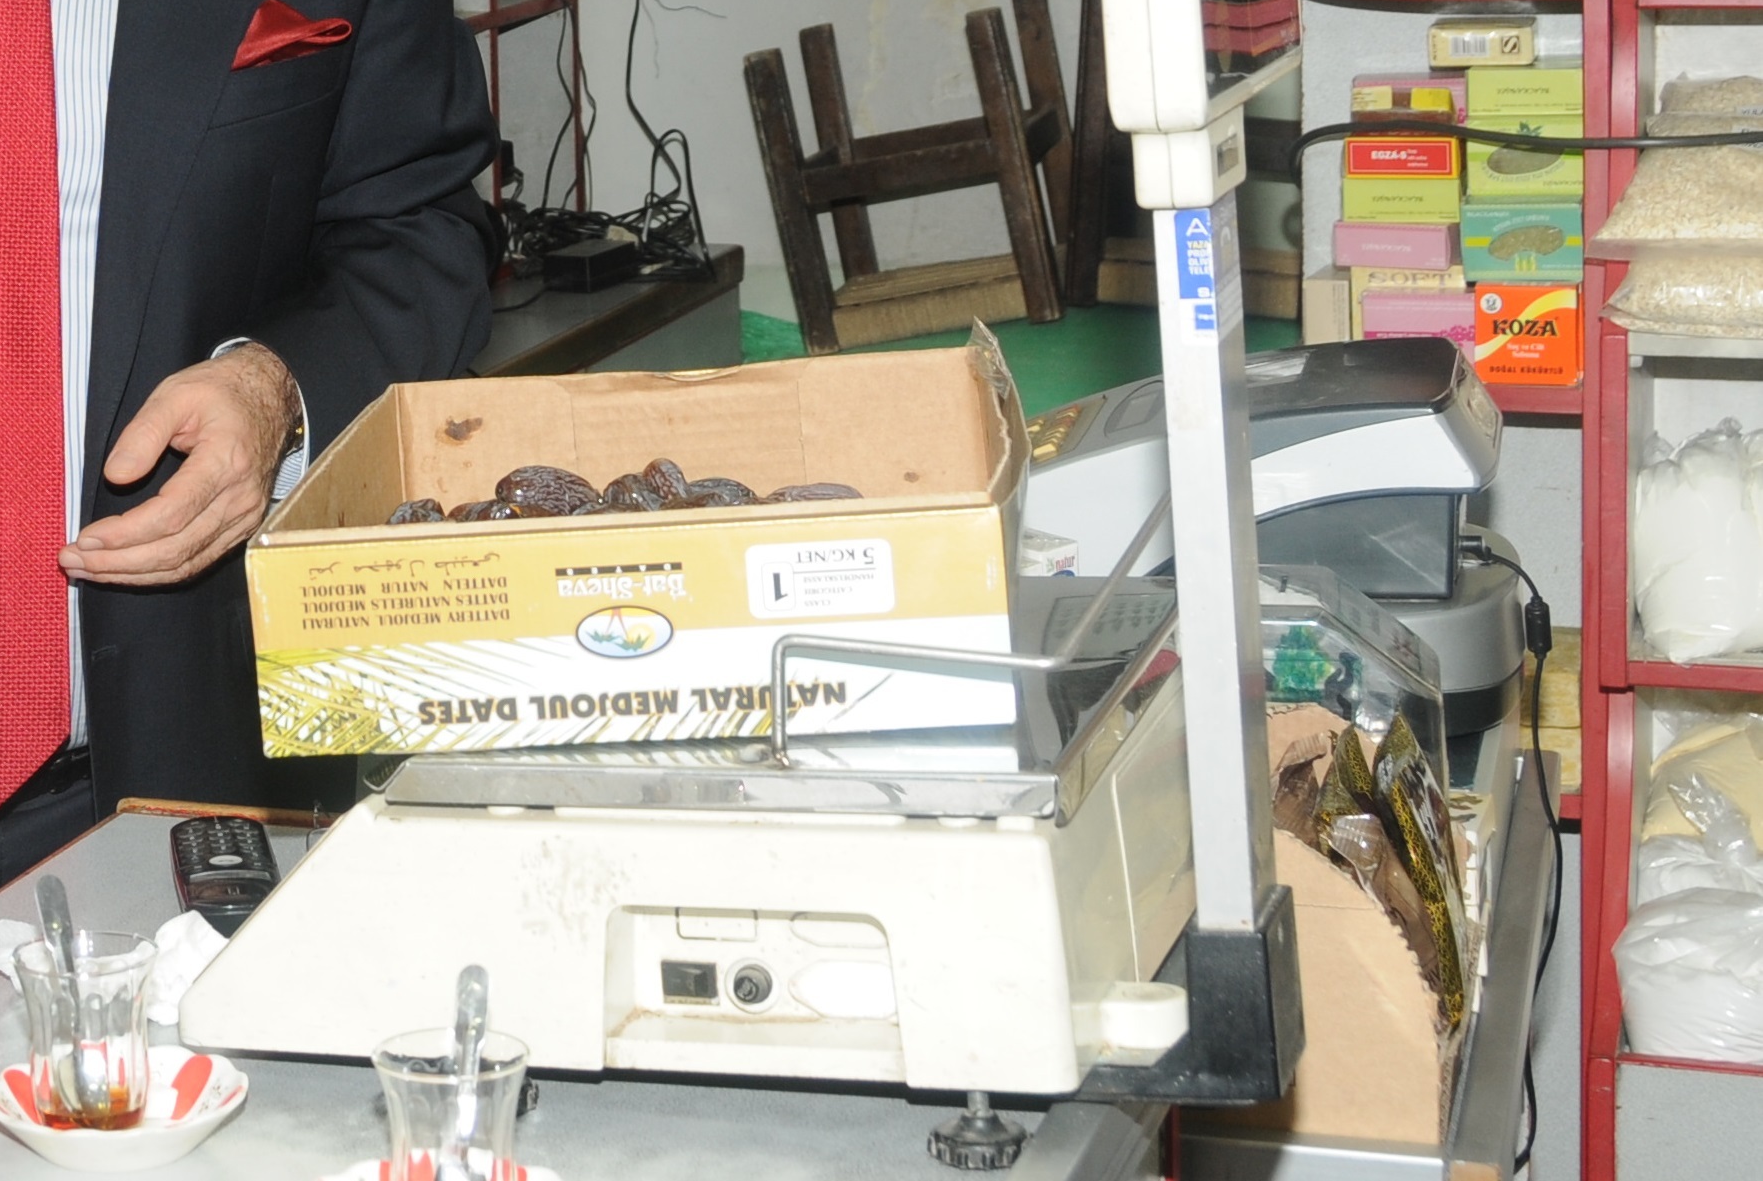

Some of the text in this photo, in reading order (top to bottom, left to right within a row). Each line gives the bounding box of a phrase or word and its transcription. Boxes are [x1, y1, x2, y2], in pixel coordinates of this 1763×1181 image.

[1367, 270, 1452, 287] SOFT
[1491, 318, 1558, 338] KOZA
[862, 547, 875, 565] 5
[300, 575, 508, 598] DATTELN NATUR MEDJOUL
[771, 571, 789, 602] 1
[301, 598, 366, 613] MEDJOUL
[455, 591, 509, 607] DATTES
[378, 611, 443, 626] MEDJOUL
[417, 696, 518, 726] DATES
[529, 687, 679, 720] MEDJOUL
